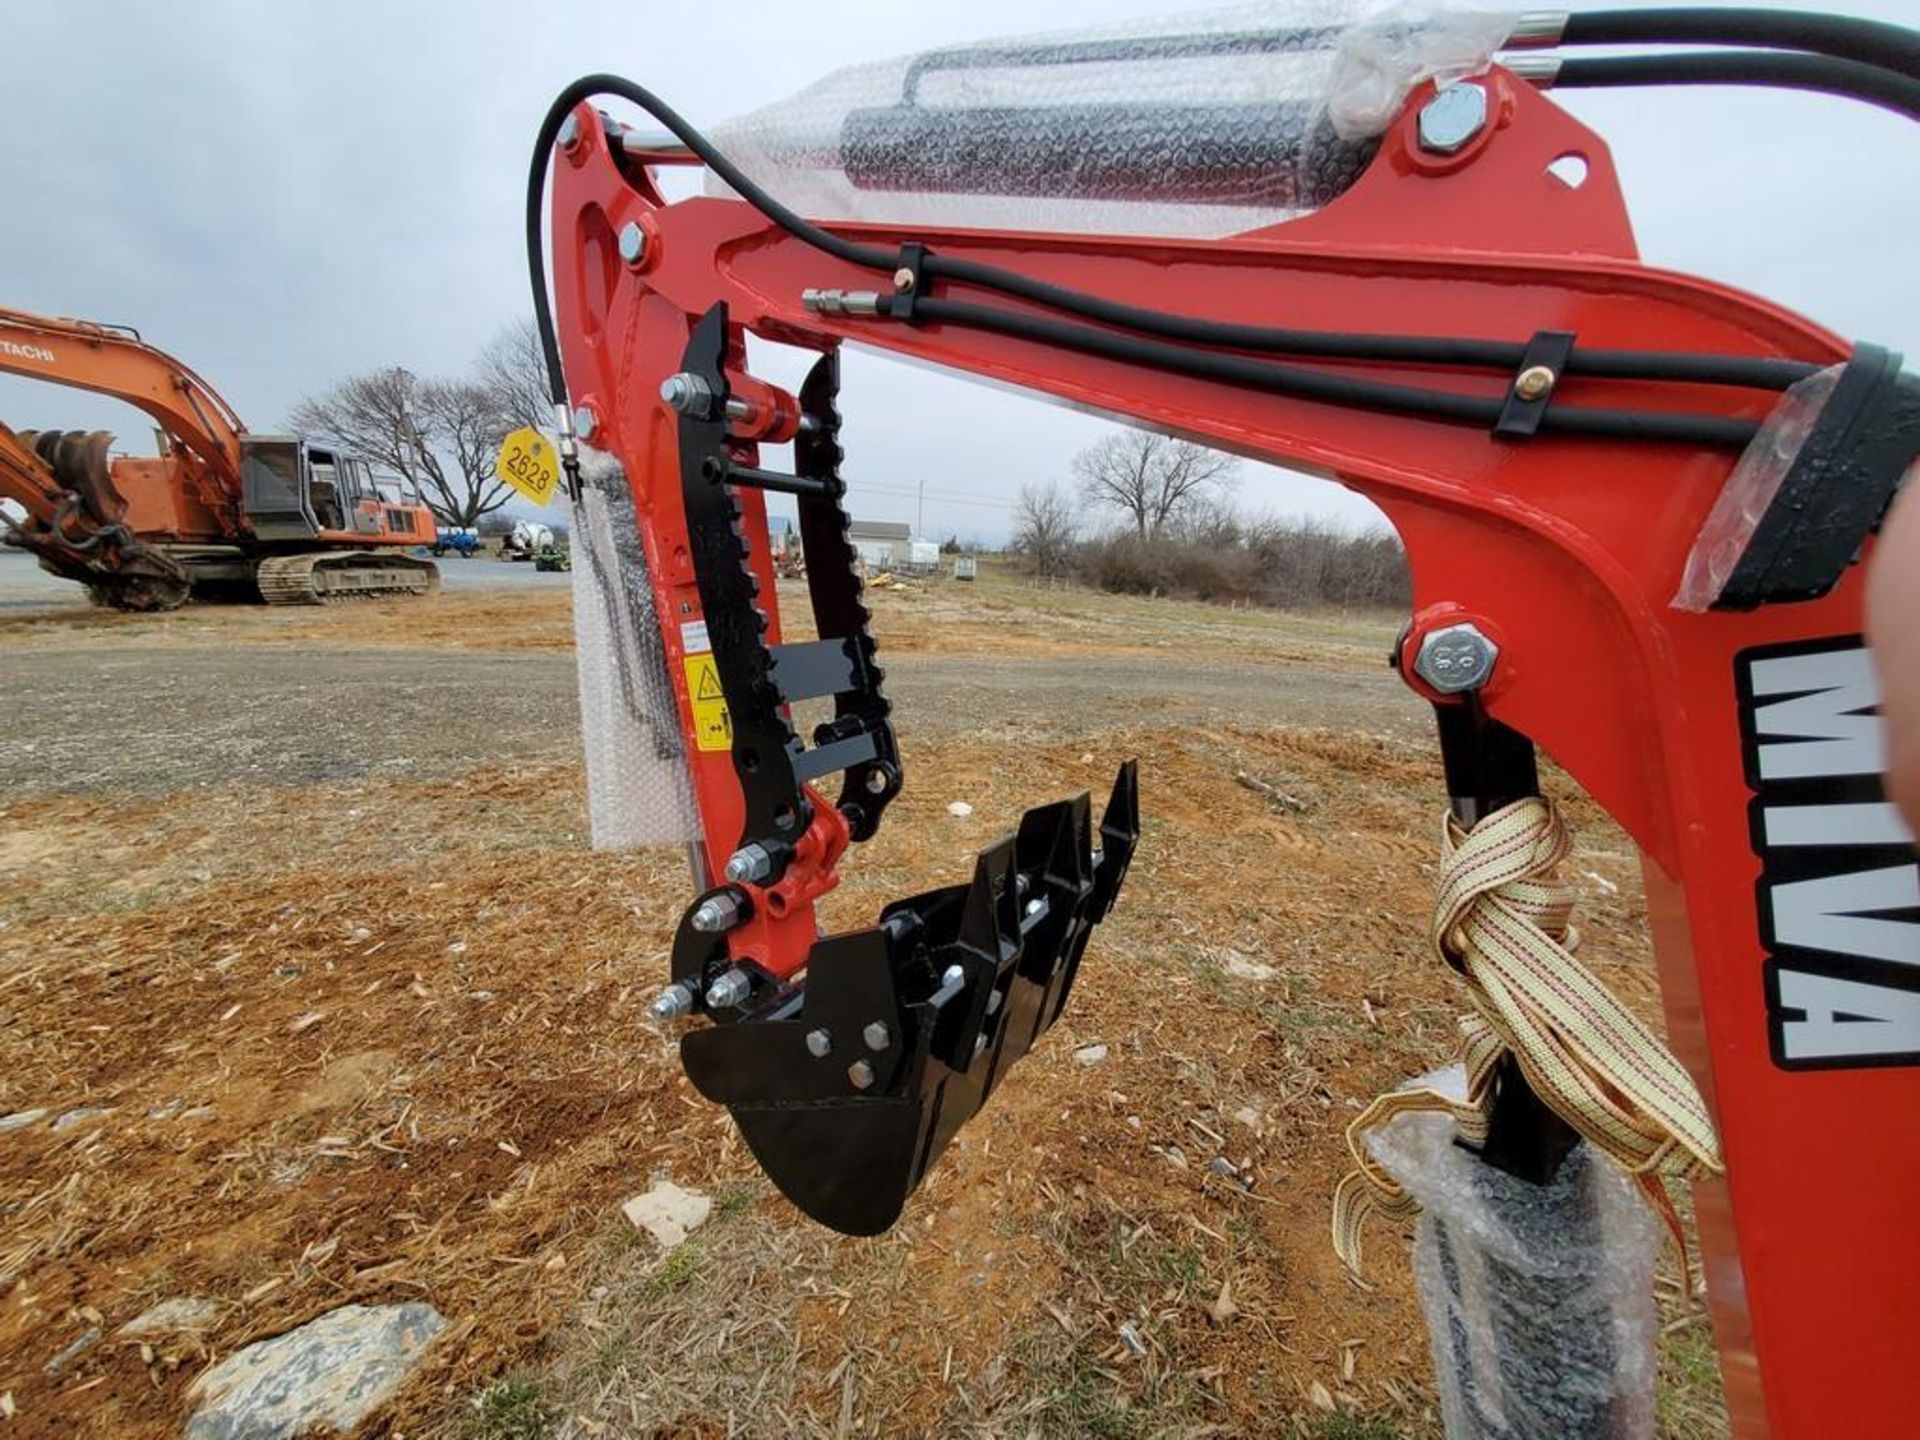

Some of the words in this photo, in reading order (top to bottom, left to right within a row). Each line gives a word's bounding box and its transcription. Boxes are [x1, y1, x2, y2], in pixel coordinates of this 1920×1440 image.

[0, 341, 55, 361] TACHI
[507, 446, 551, 491] 2628
[1747, 645, 1920, 1060] MIVA
